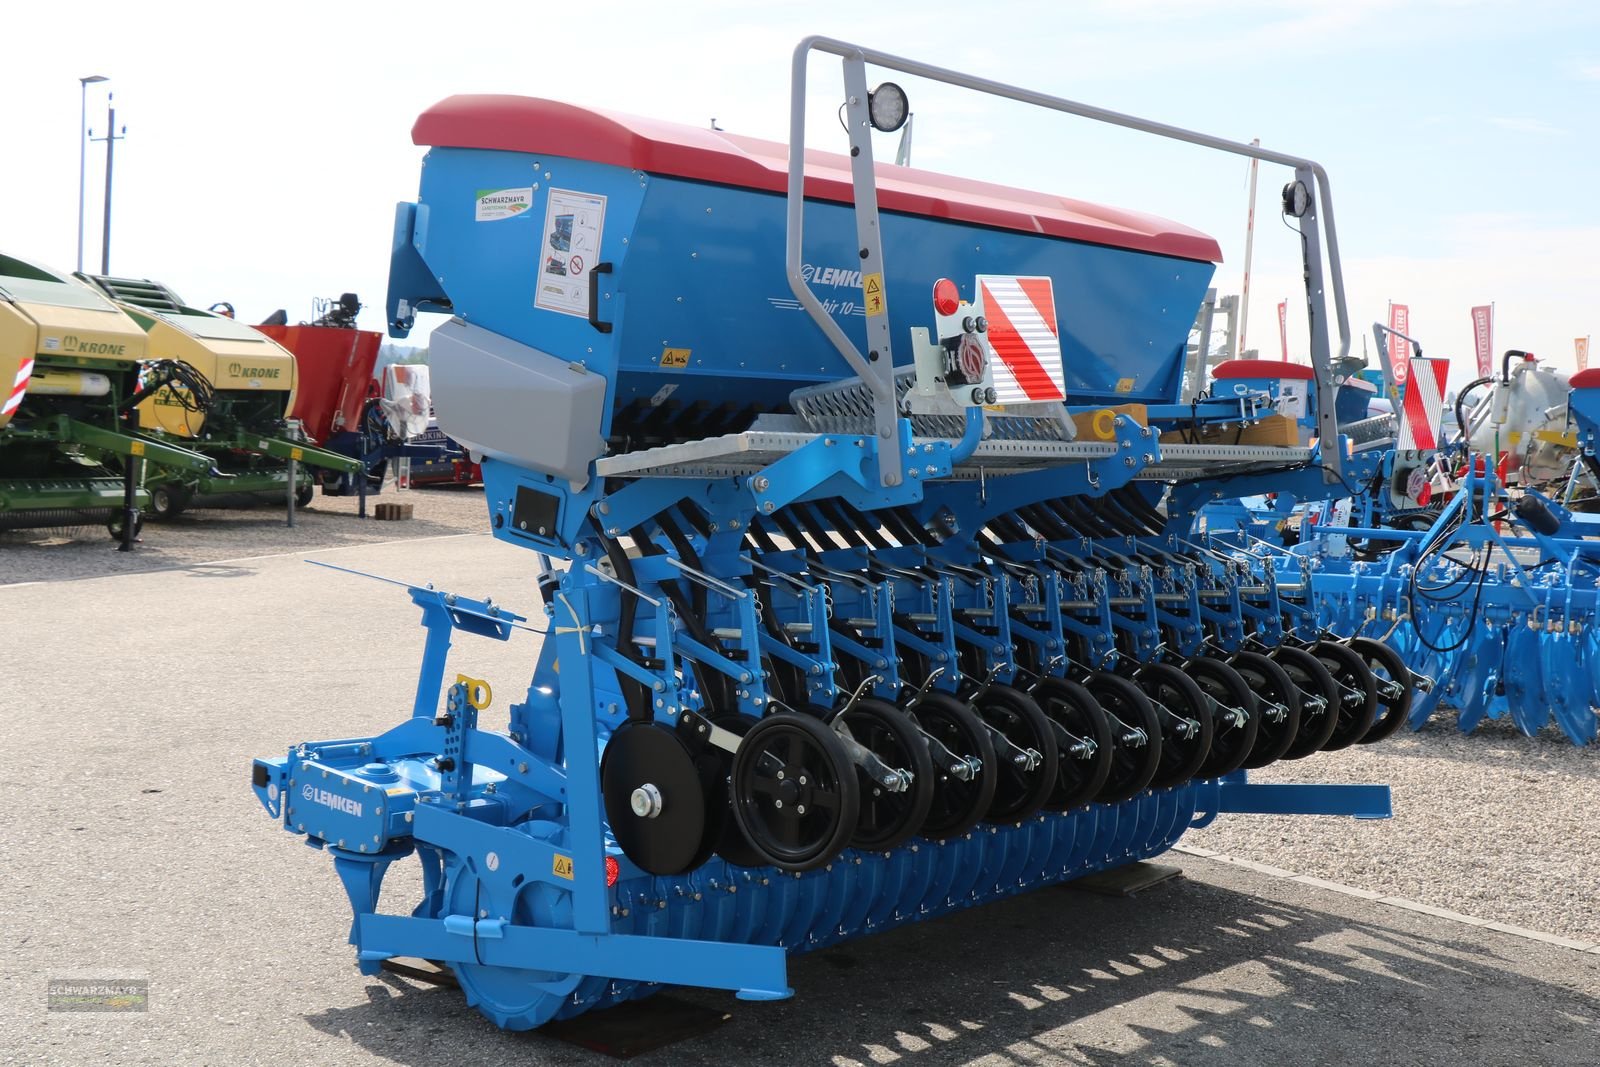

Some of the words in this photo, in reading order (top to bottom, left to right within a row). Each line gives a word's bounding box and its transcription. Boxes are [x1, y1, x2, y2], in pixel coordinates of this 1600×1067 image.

[481, 196, 524, 204] SCHWARZMAYR
[812, 267, 864, 288] LEMKE
[839, 302, 854, 315] 10
[78, 341, 126, 356] KRONE
[242, 367, 281, 379] KRONE
[314, 788, 362, 817] LEMKEN
